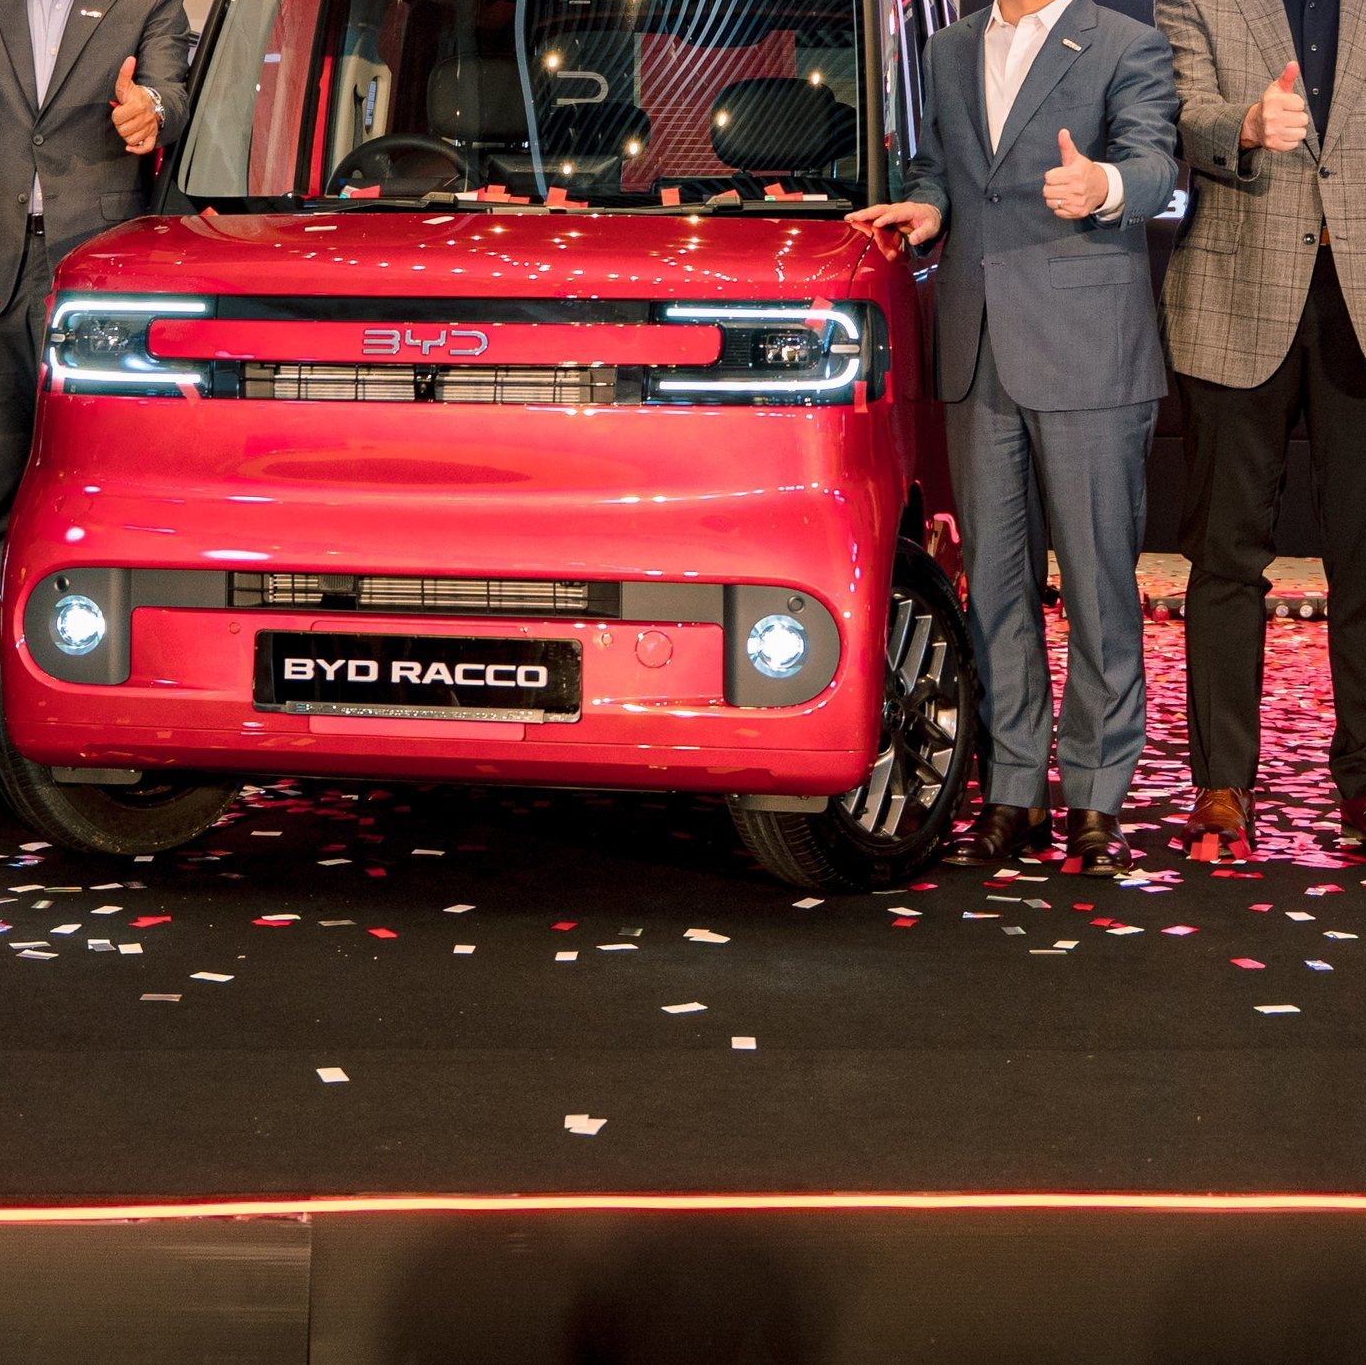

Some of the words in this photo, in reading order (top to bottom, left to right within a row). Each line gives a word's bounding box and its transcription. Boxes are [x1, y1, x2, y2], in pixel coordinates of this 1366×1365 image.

[362, 329, 488, 355] BYD
[284, 657, 379, 683] BYD
[391, 660, 548, 688] RACCO
